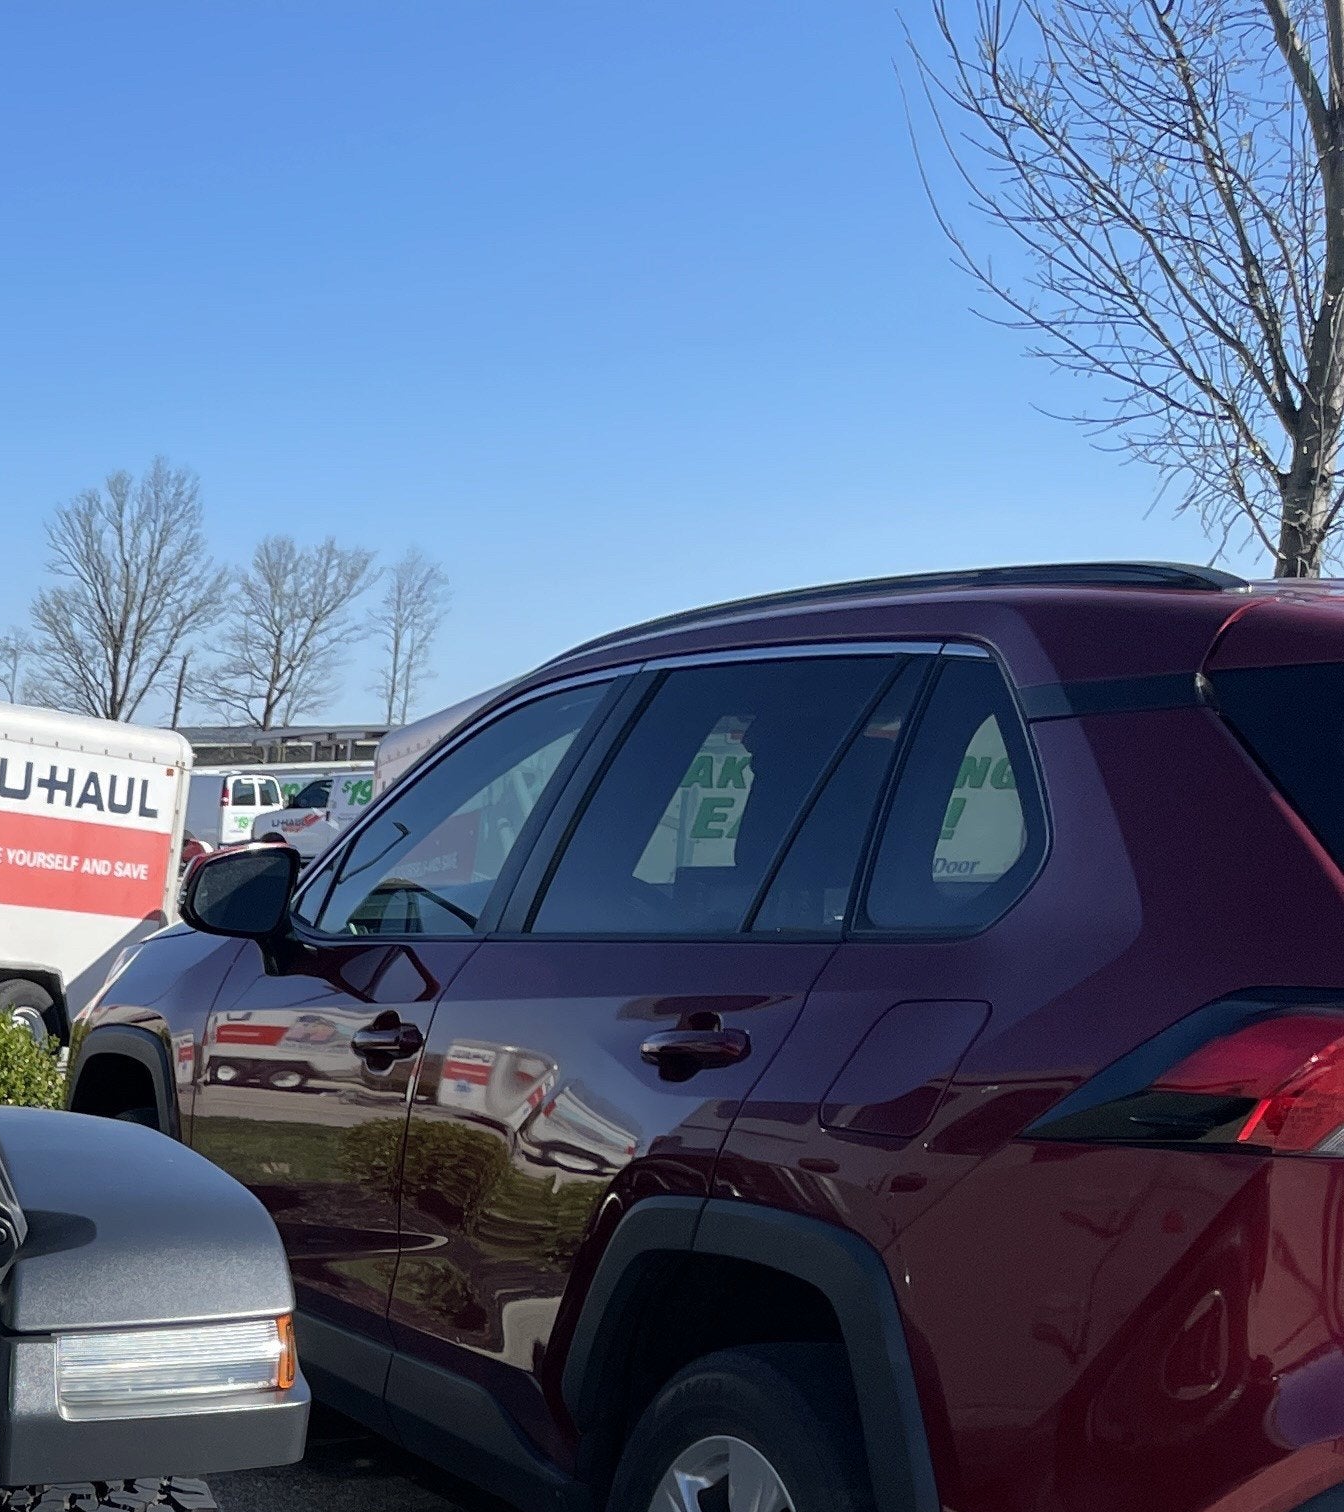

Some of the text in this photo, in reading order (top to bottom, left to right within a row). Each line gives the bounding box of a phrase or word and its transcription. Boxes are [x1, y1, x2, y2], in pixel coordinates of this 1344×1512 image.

[5, 848, 79, 873] YOURSELF
[80, 860, 113, 876] AND
[114, 861, 149, 881] SAVE
